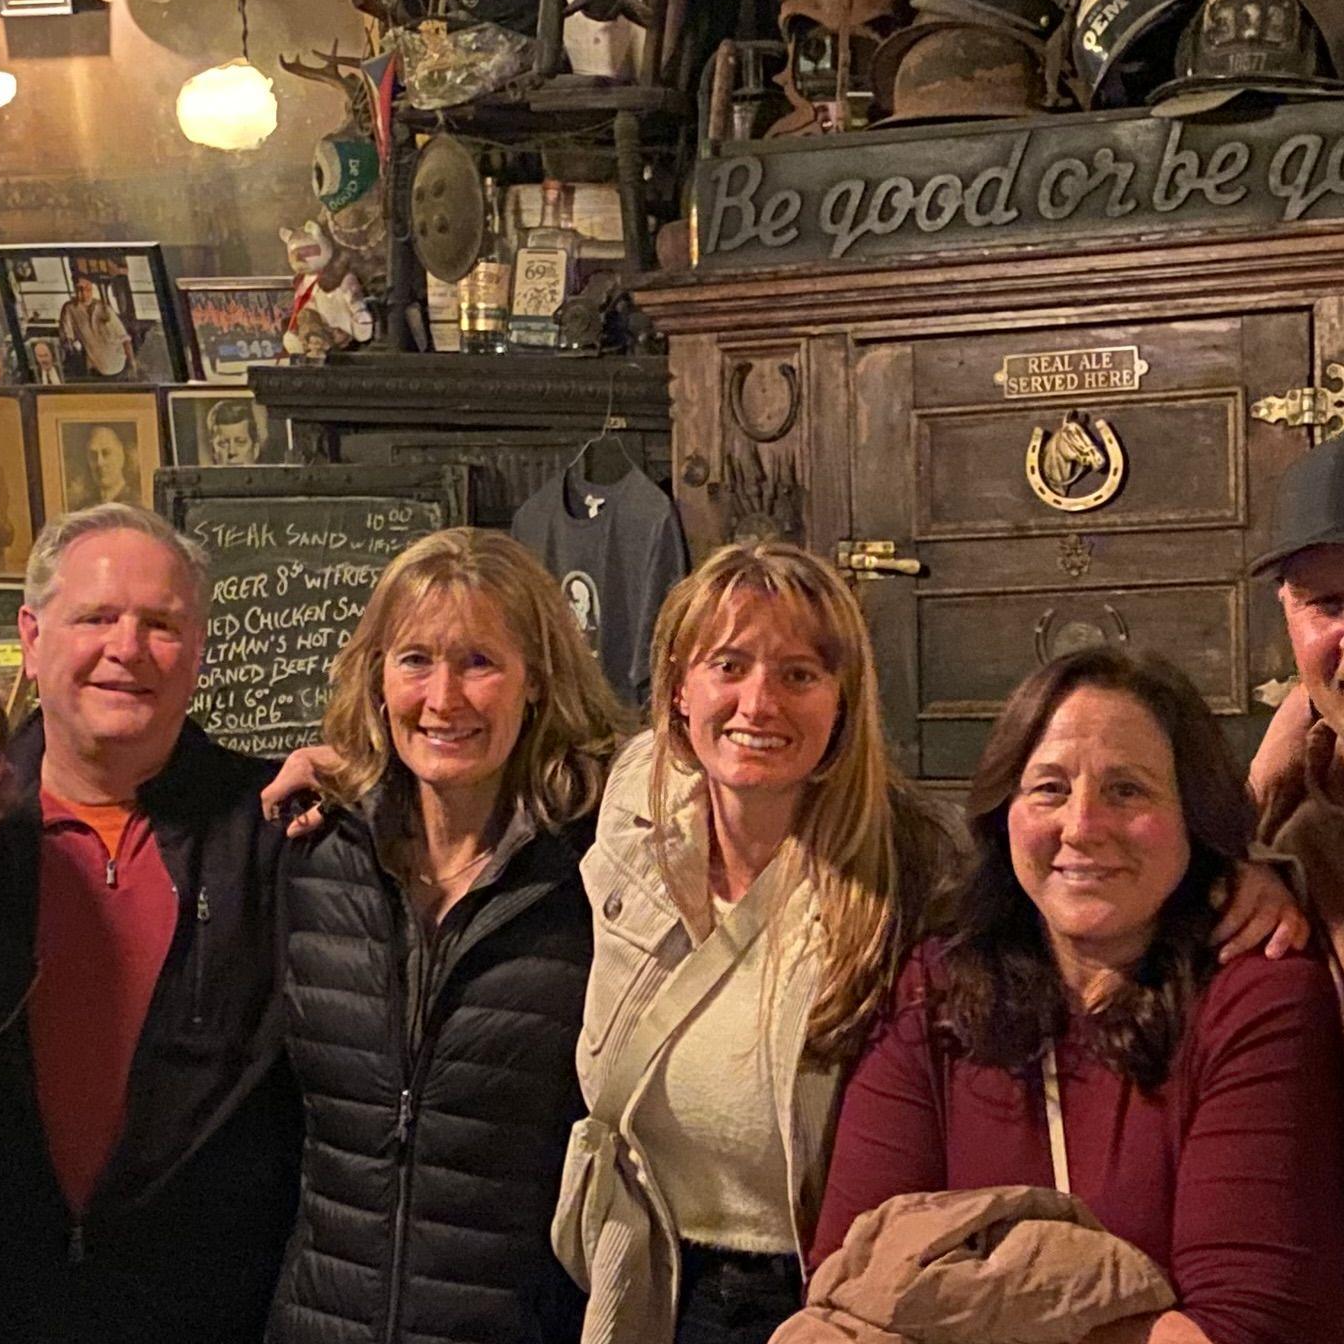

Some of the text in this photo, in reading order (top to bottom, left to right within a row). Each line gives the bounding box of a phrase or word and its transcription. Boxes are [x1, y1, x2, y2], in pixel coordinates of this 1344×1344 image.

[705, 155, 803, 255] Be
[819, 130, 1033, 258] good
[1037, 147, 1137, 221] or
[1152, 119, 1251, 213] be
[1027, 352, 1114, 374] REAL ALE
[1007, 369, 1134, 394] SERVED HERE
[193, 520, 277, 548] STEAK
[211, 573, 269, 604] RGER
[207, 613, 241, 641] IED
[244, 599, 332, 634] CHICKEN
[297, 628, 336, 651] HOT
[197, 665, 265, 689] ORNED
[268, 655, 320, 687] BEEF
[207, 705, 268, 731] SOUP
[217, 730, 319, 752] SANDWICHE
